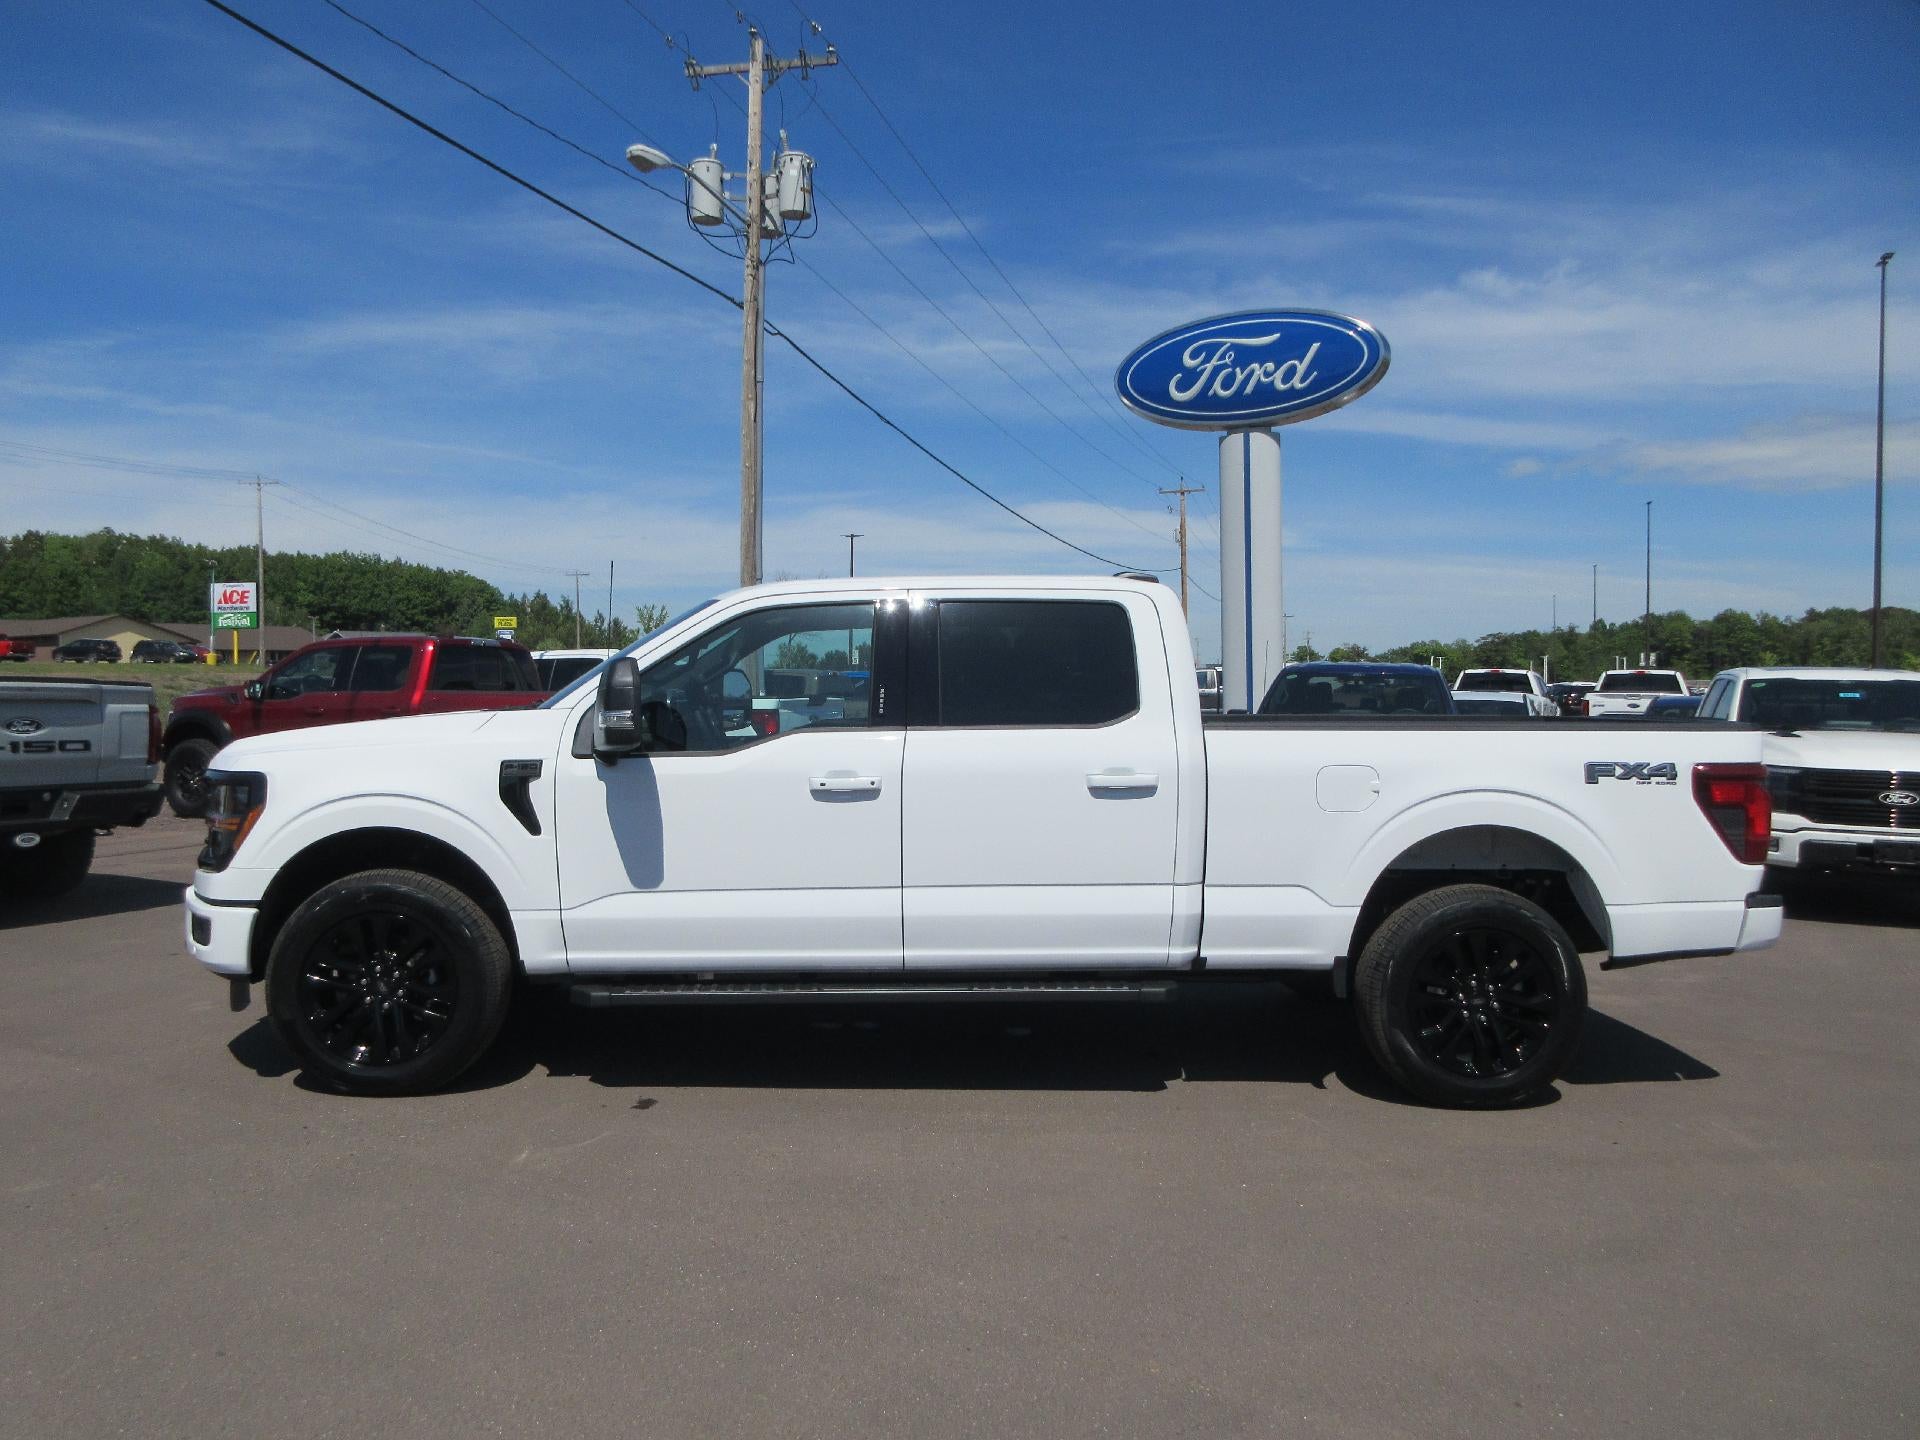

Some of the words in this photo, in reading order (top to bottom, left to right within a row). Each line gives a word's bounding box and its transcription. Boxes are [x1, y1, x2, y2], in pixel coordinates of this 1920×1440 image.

[1168, 333, 1321, 401] Ford
[217, 589, 250, 605] ACE
[10, 720, 38, 732] Ford
[0, 740, 91, 753] -150
[1584, 762, 1677, 784] FX4
[1886, 794, 1913, 804] Ford
